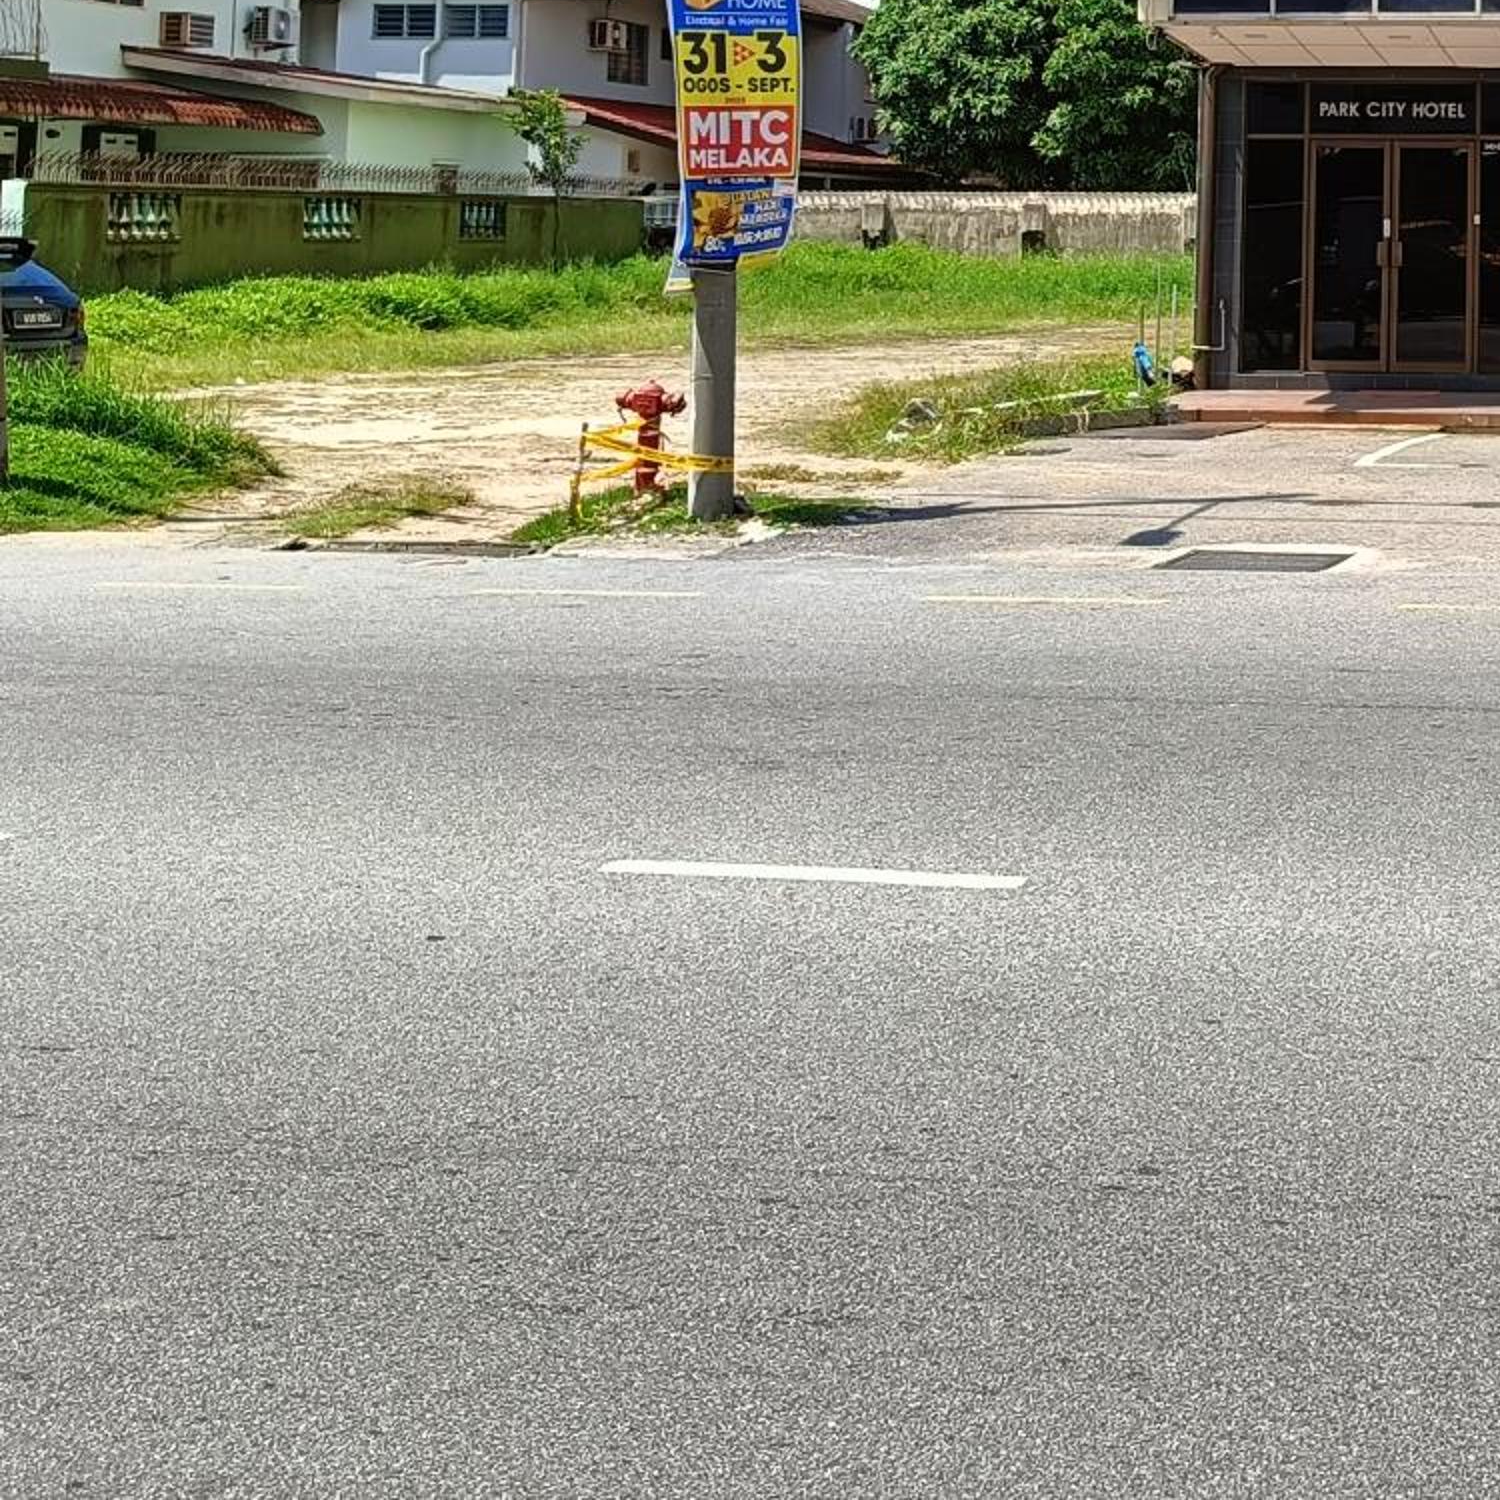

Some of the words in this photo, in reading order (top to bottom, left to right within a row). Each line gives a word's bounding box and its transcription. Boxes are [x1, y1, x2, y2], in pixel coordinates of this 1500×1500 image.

[682, 31, 727, 74] 31
[755, 31, 787, 73] 3
[683, 77, 731, 93] OGOS
[747, 77, 795, 93] SEPT.
[1319, 102, 1360, 117] PARK
[1366, 102, 1406, 117] CITY
[1412, 102, 1466, 118] HOTEL
[689, 110, 790, 145] MITC
[689, 147, 789, 169] MELAKA
